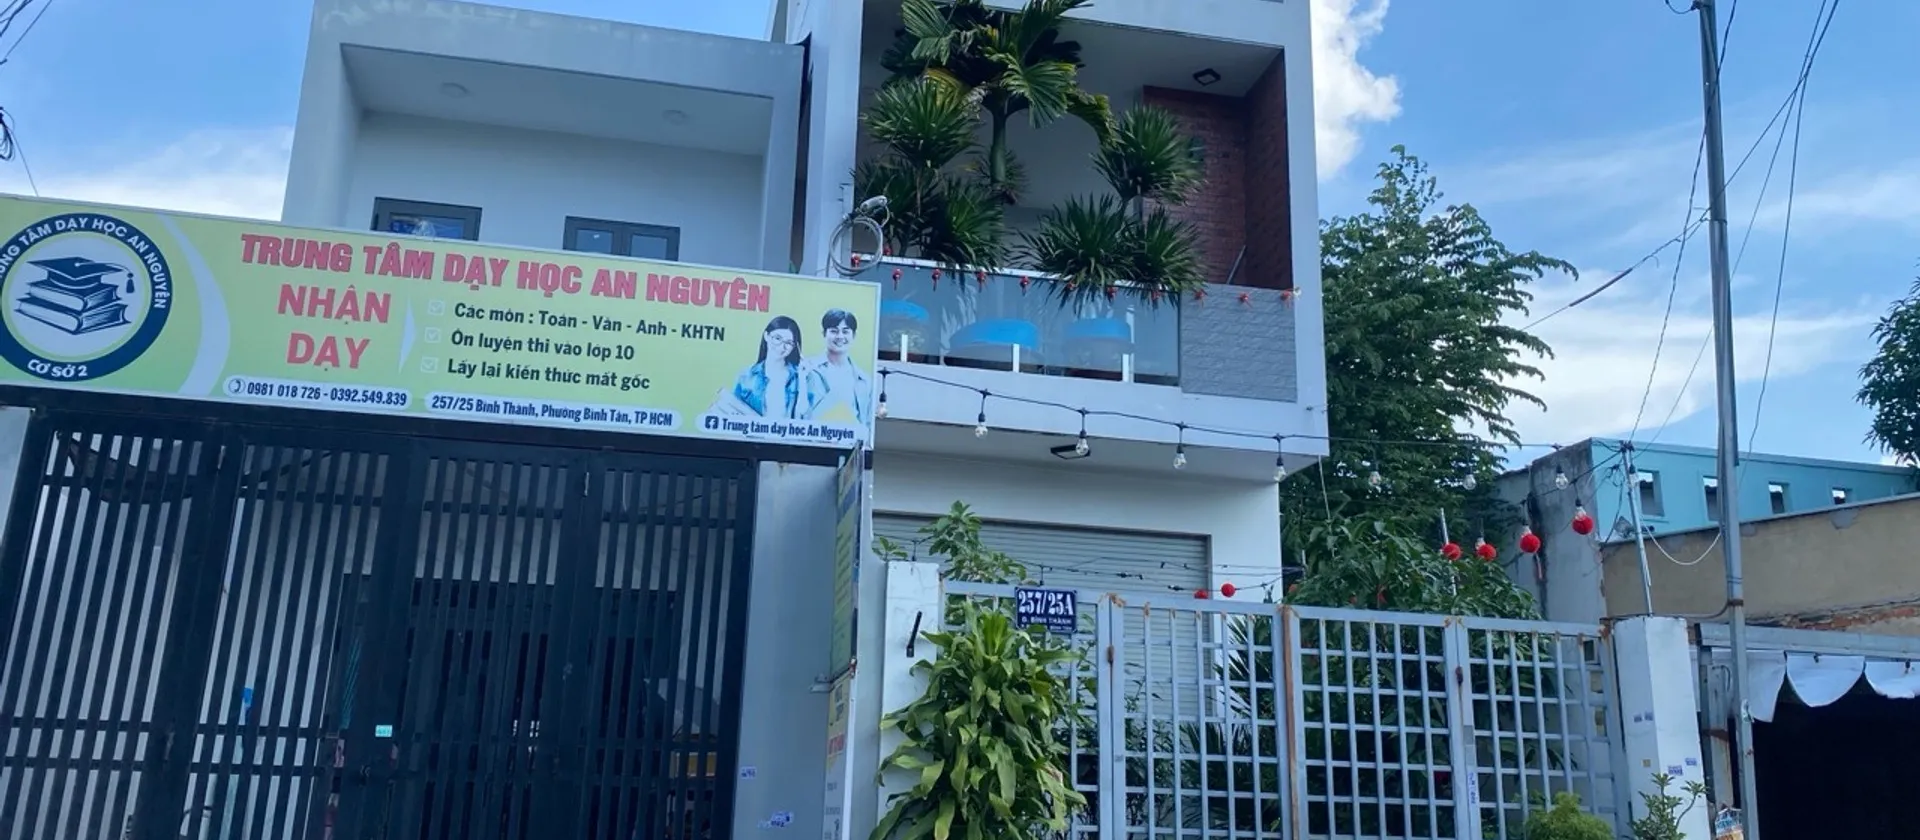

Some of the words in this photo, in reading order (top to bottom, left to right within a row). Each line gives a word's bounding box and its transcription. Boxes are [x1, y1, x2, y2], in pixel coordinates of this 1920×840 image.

[0, 245, 20, 278] UNG
[55, 217, 89, 231] DẠY
[92, 219, 128, 236] HỌC
[128, 235, 149, 253] AN
[144, 252, 170, 308] NGUYÊN
[241, 233, 353, 273] TRUNG
[363, 241, 435, 280] TÂM
[443, 253, 509, 290] DẠY
[517, 260, 583, 298] HỌC
[590, 268, 638, 299] AN
[646, 273, 771, 312] NGUYÊN
[278, 283, 391, 325] NHẬN
[454, 302, 485, 320] Các
[538, 310, 577, 328] Toán
[636, 319, 667, 336] Anh
[681, 323, 725, 341] KHTN
[287, 332, 371, 372] DẠY
[528, 337, 550, 353] thi
[615, 345, 635, 360] 10
[78, 365, 88, 377] 2
[448, 358, 476, 379] Lấy
[481, 361, 501, 379] lại
[505, 363, 540, 380] kiến
[247, 382, 273, 396] 0981
[277, 384, 298, 399] 018
[302, 386, 321, 400] 726
[330, 388, 407, 406] 0392.549.839
[432, 395, 474, 411] 257/25
[634, 410, 648, 425] TP
[649, 412, 673, 426] HCM
[722, 418, 749, 434] Trung
[807, 424, 819, 437] An
[1018, 590, 1074, 615] 257/25A
